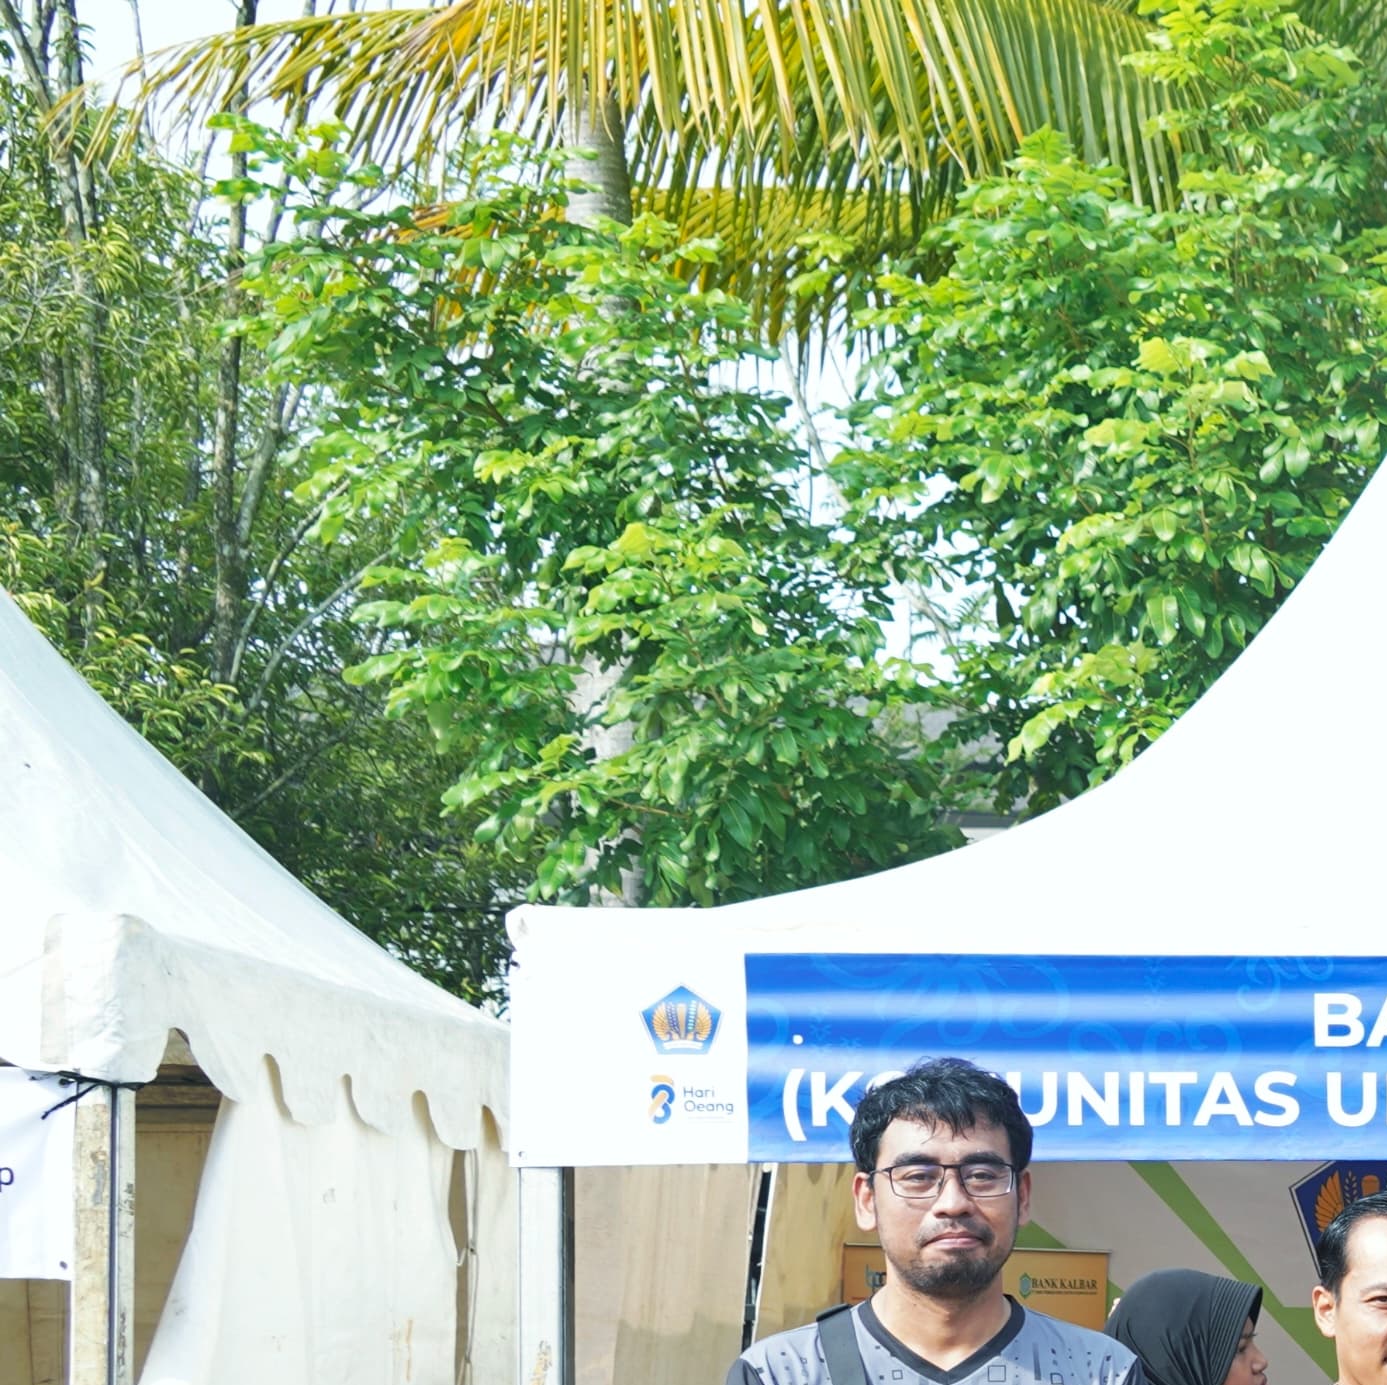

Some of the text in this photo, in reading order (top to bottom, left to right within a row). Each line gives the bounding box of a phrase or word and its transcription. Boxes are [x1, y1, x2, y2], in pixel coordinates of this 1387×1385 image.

[683, 1086, 715, 1098] Hari
[684, 1100, 734, 1115] Oeang
[783, 1069, 1300, 1142] (KUNITAS
[1032, 1278, 1097, 1290] BANK KALBAR
